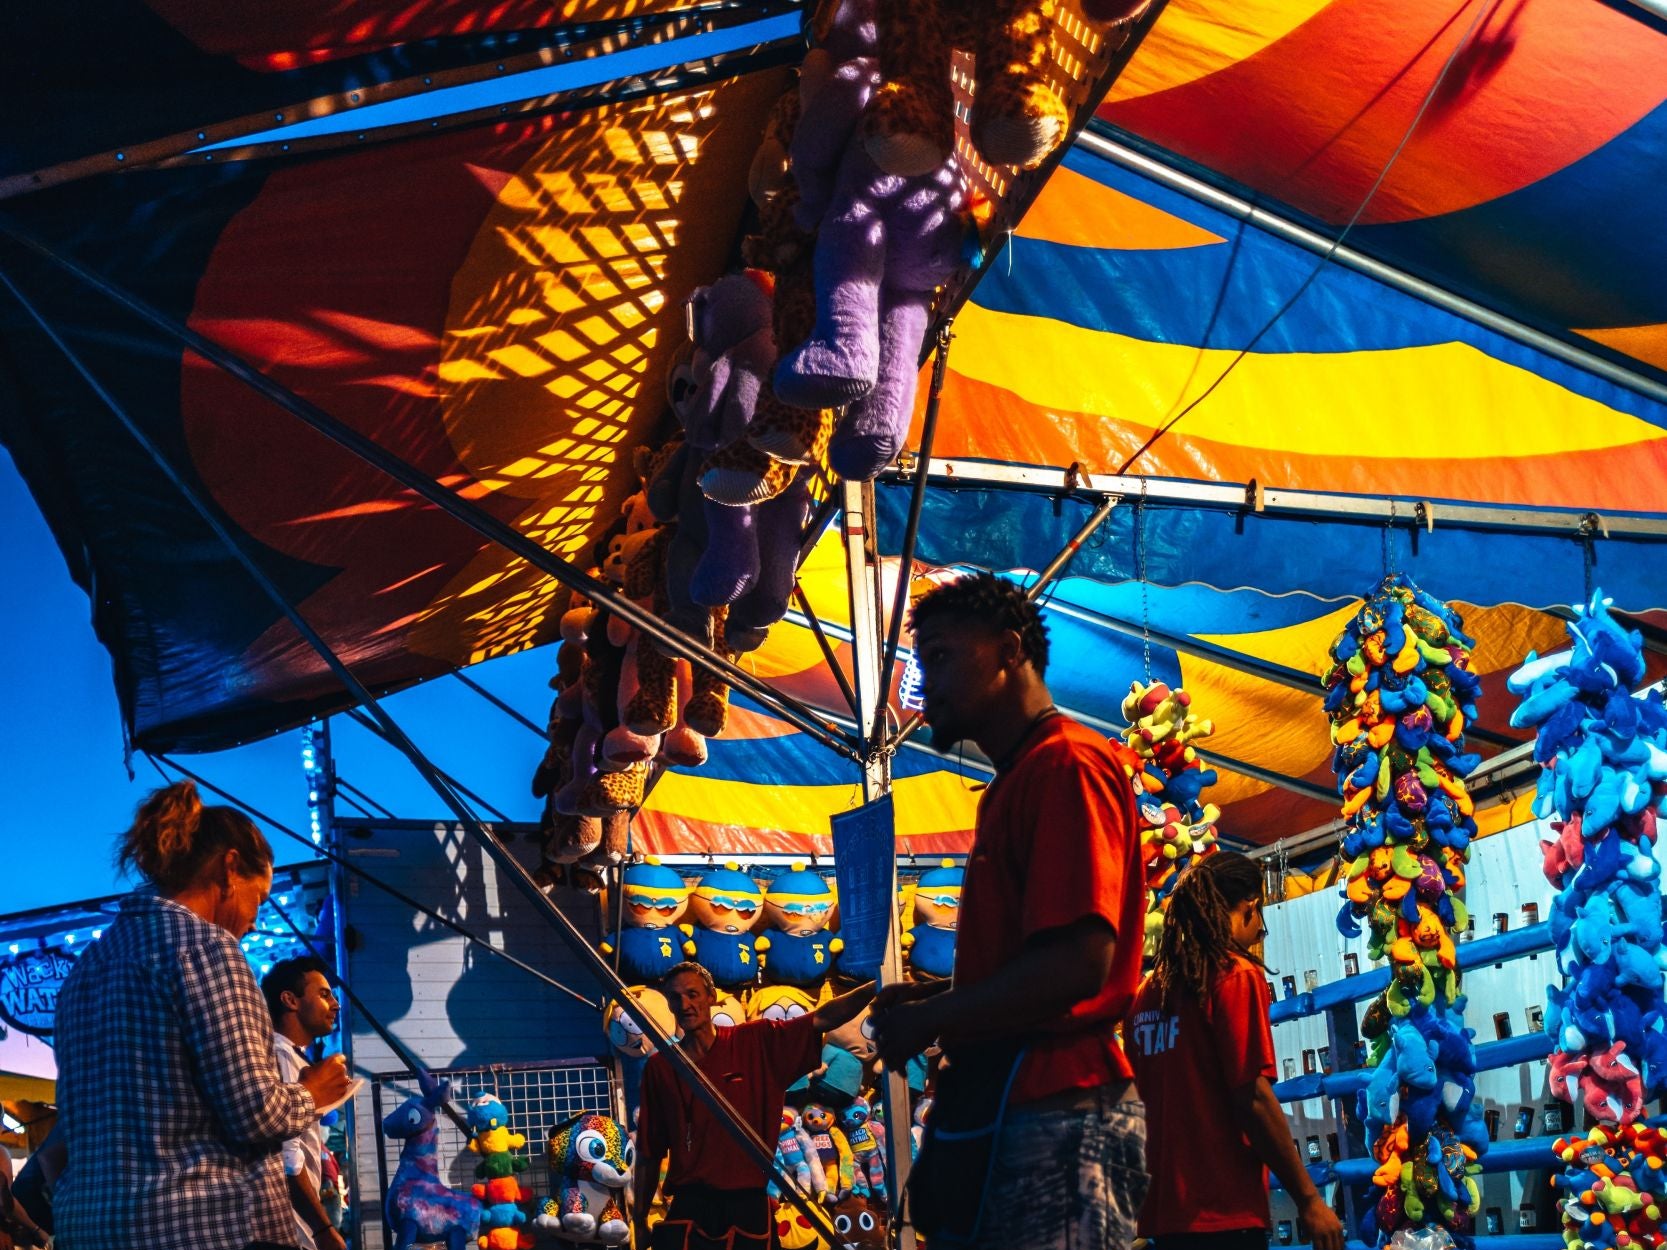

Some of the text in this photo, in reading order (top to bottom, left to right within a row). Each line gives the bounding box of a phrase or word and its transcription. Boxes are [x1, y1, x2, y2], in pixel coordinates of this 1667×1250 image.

[2, 953, 74, 987] Wack
[0, 987, 60, 1017] WAT
[1133, 1015, 1180, 1056] STAF
